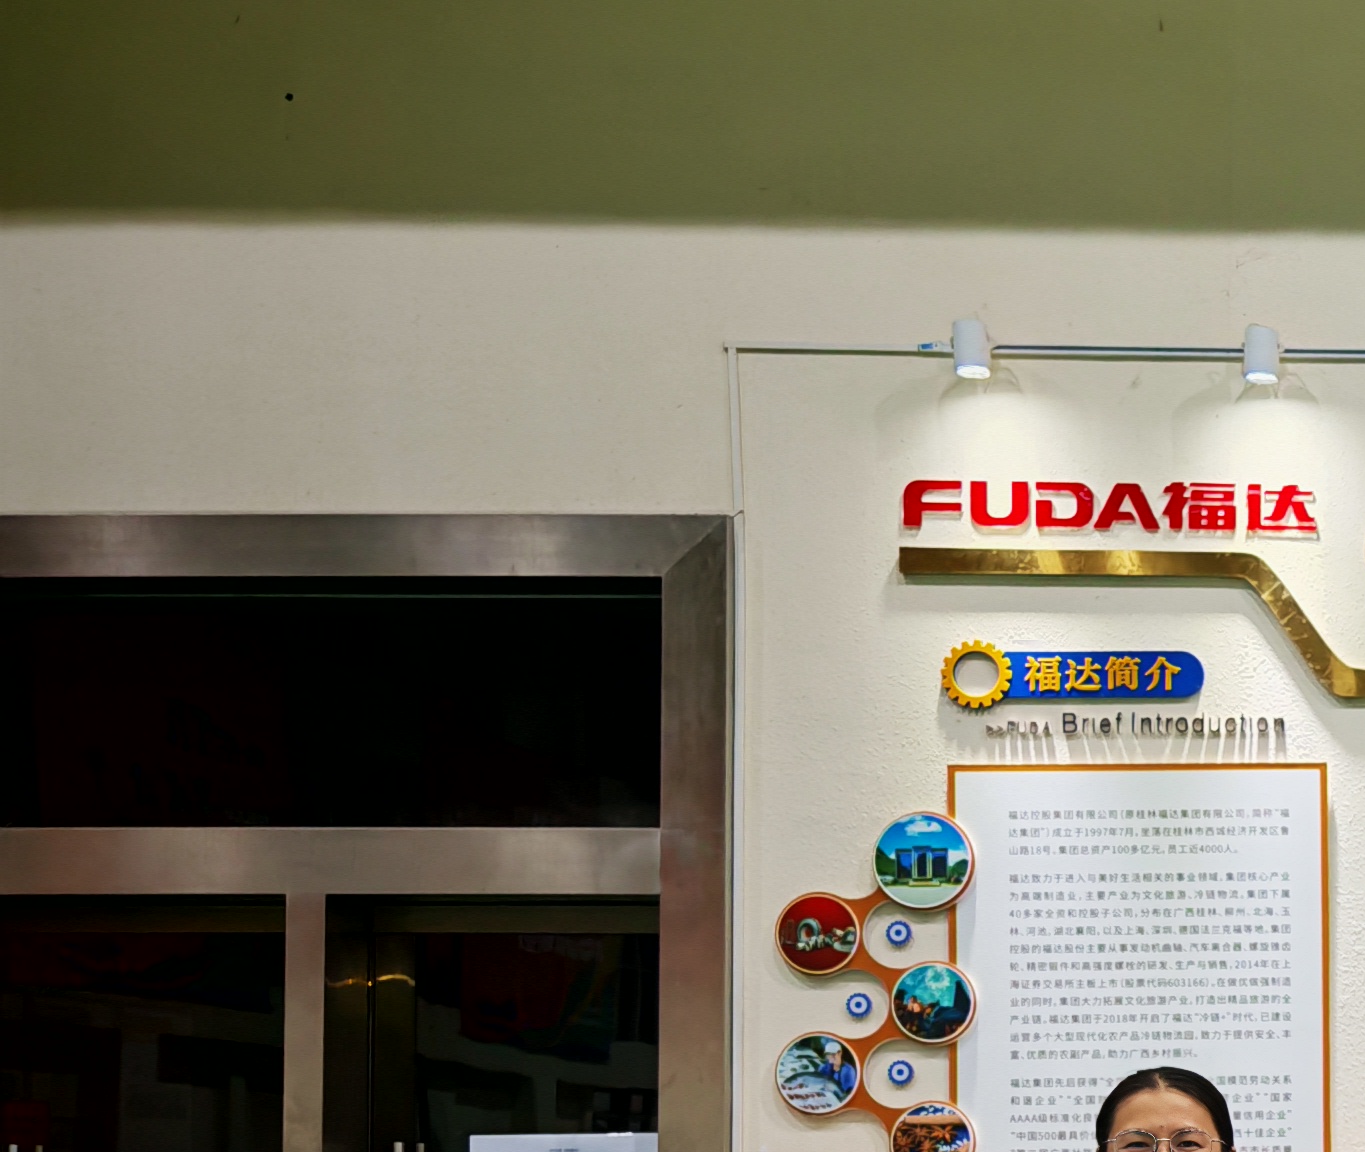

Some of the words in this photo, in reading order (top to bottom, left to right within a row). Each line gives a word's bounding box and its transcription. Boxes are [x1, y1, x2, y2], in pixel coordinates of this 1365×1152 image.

[1023, 655, 1182, 693] 福达简介
[1062, 711, 1125, 734] Brief
[1130, 711, 1286, 734] Introduction
